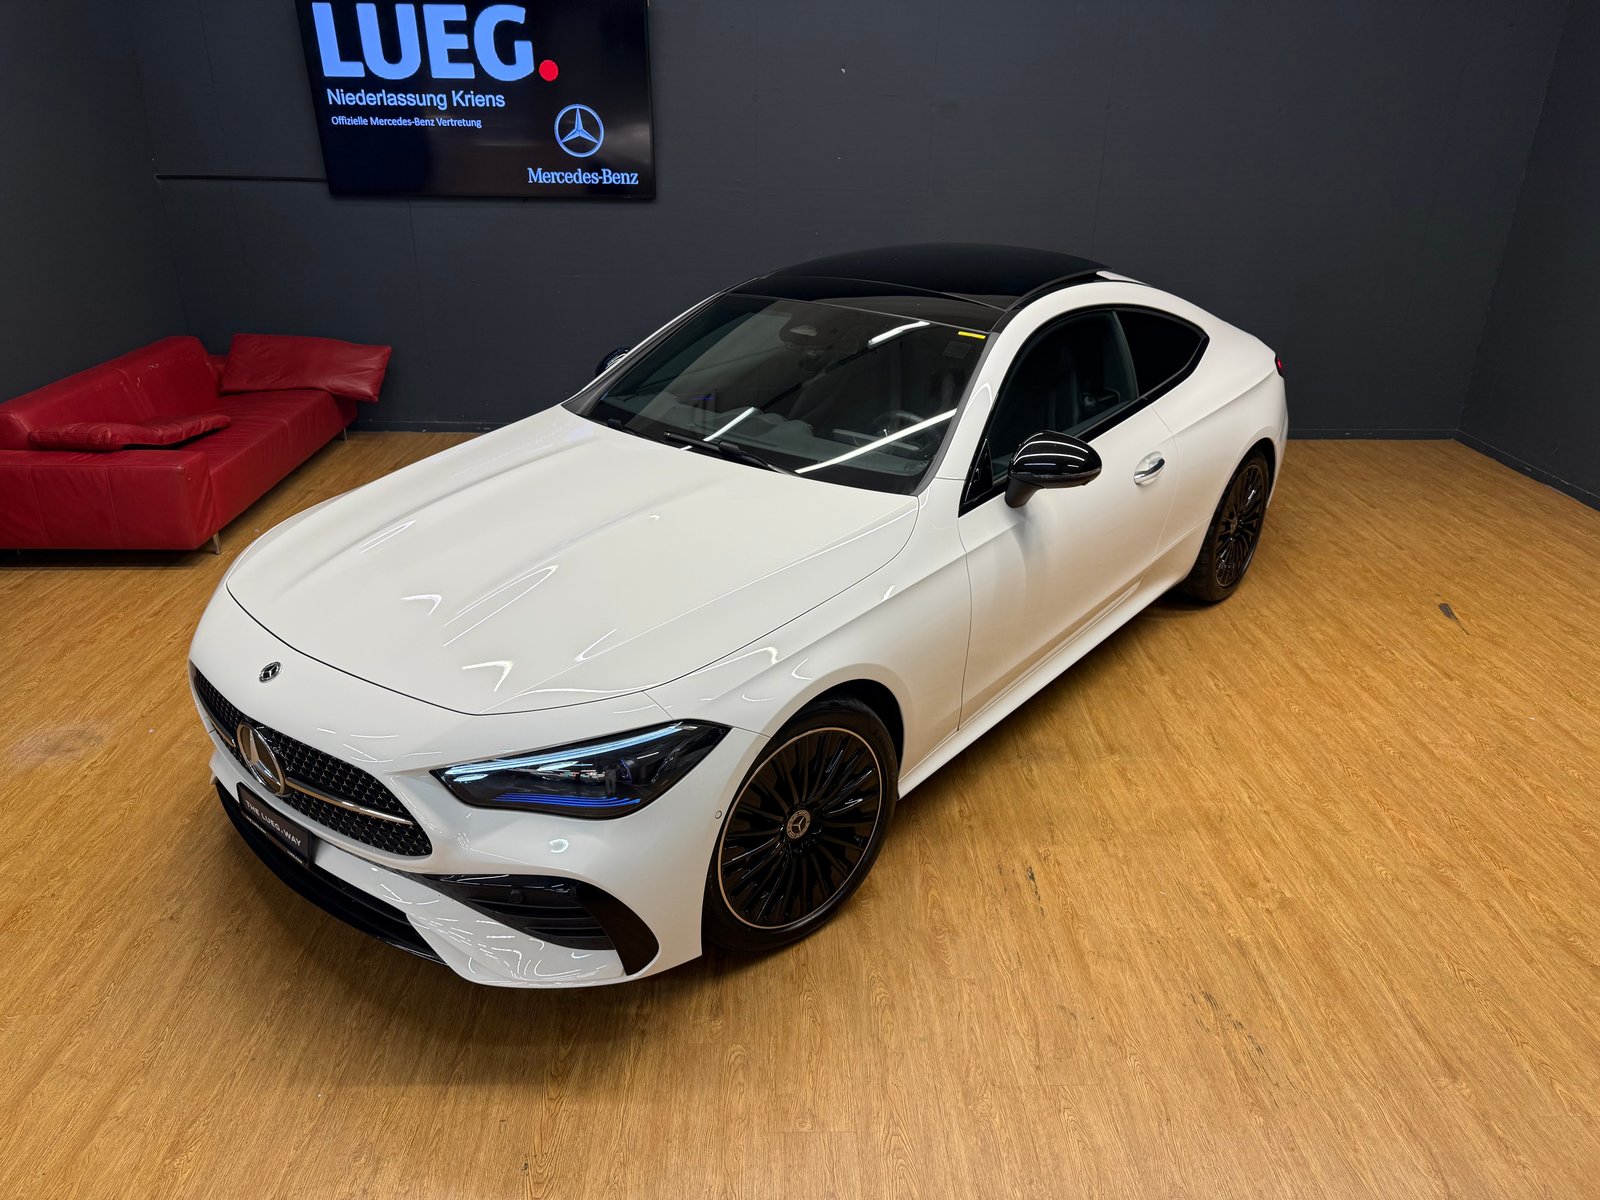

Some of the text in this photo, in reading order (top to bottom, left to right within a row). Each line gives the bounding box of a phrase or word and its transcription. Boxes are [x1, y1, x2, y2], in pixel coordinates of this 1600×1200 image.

[312, 2, 559, 82] LUEG.
[326, 88, 506, 110] Niederlassung Kriens
[331, 116, 482, 128] Offizielle Mercedes-Benz Vertretung
[527, 167, 639, 185] Mercedes-Benz
[245, 799, 260, 816] THE
